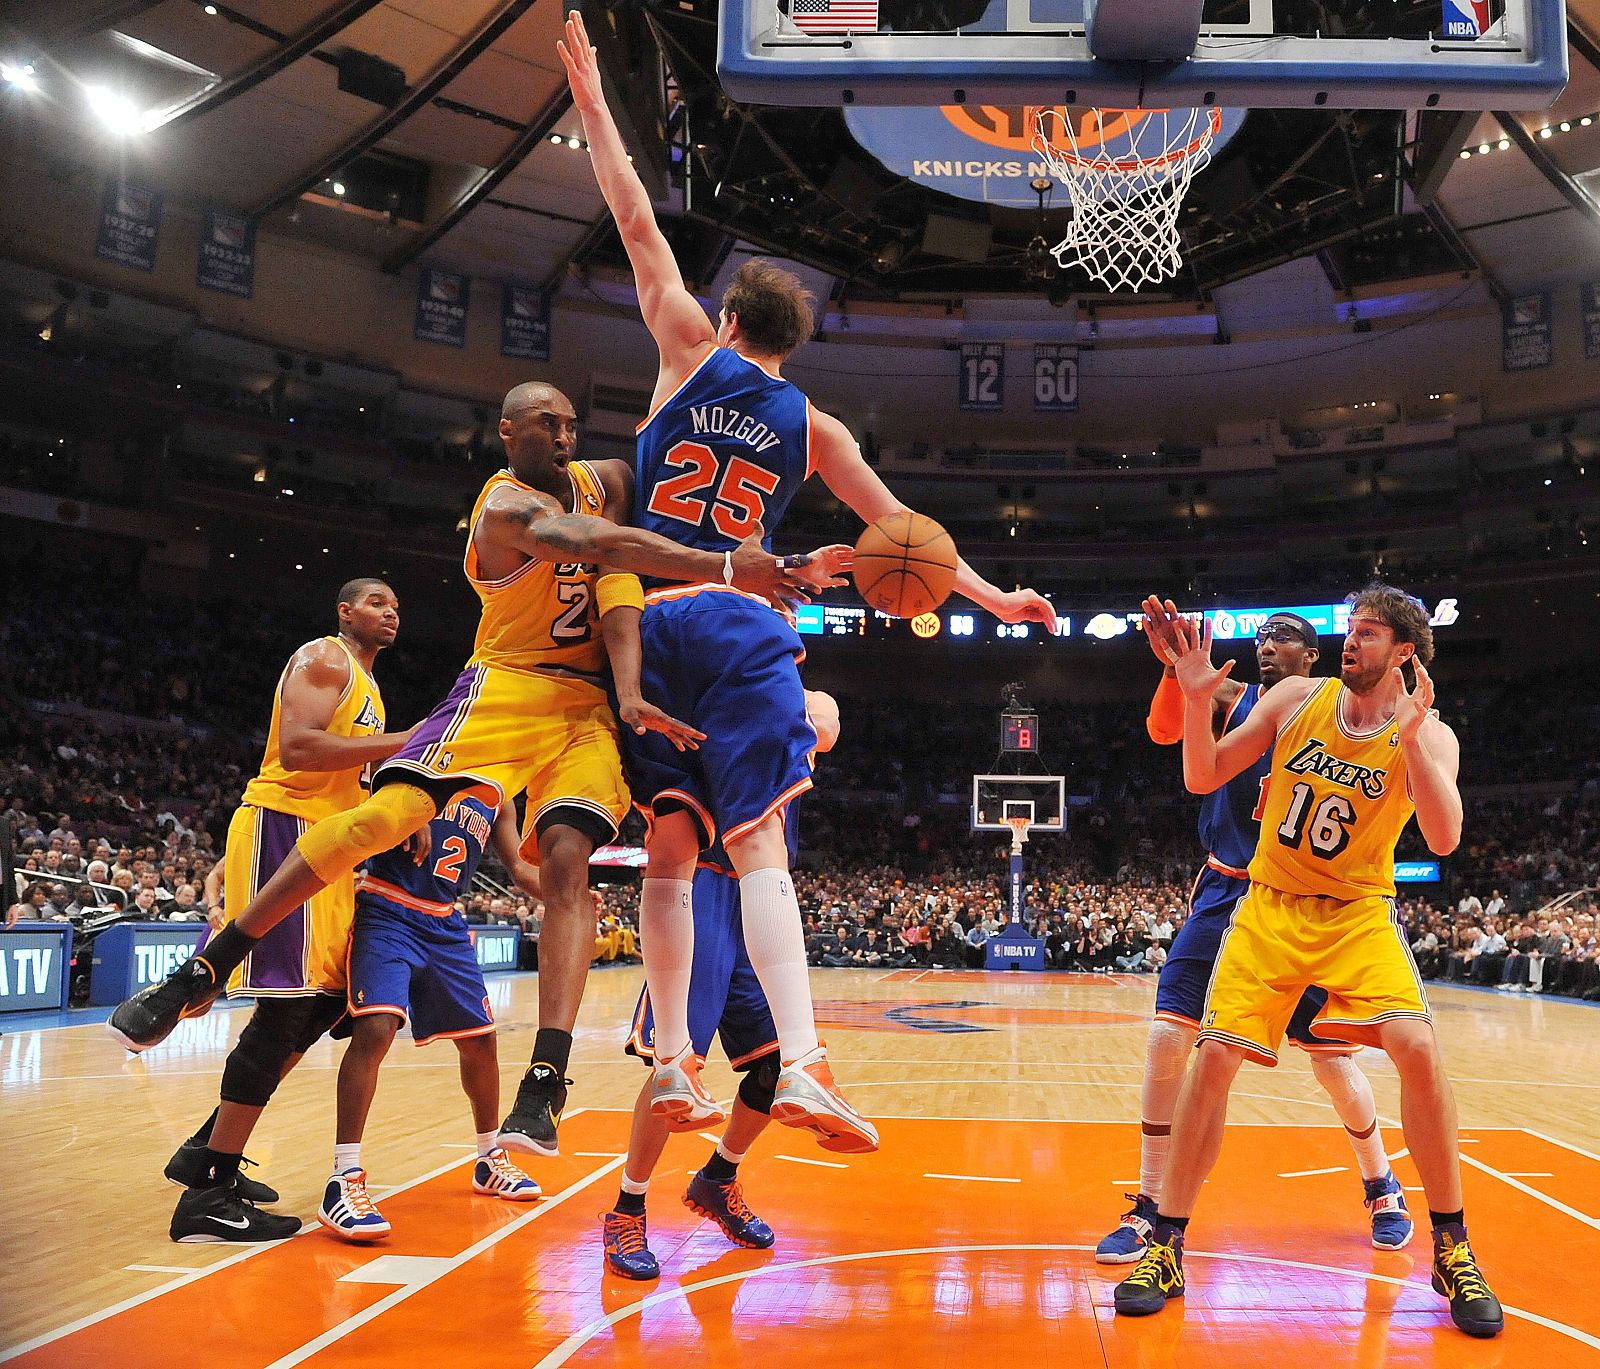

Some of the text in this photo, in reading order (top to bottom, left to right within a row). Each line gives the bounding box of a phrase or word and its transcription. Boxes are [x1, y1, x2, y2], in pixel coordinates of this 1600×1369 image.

[1448, 22, 1475, 35] NBA
[913, 160, 1022, 178] KNICKS
[966, 359, 998, 402] 12
[1035, 358, 1078, 403] 60
[690, 406, 781, 453] MOZGOV
[647, 439, 781, 543] 25
[550, 580, 593, 646] 2
[1019, 729, 1032, 749] 8
[1284, 738, 1388, 800] LAKERS
[1278, 782, 1357, 861] 16
[432, 835, 467, 884] 2
[13, 948, 53, 995] TV
[1004, 946, 1036, 957] NBA TV
